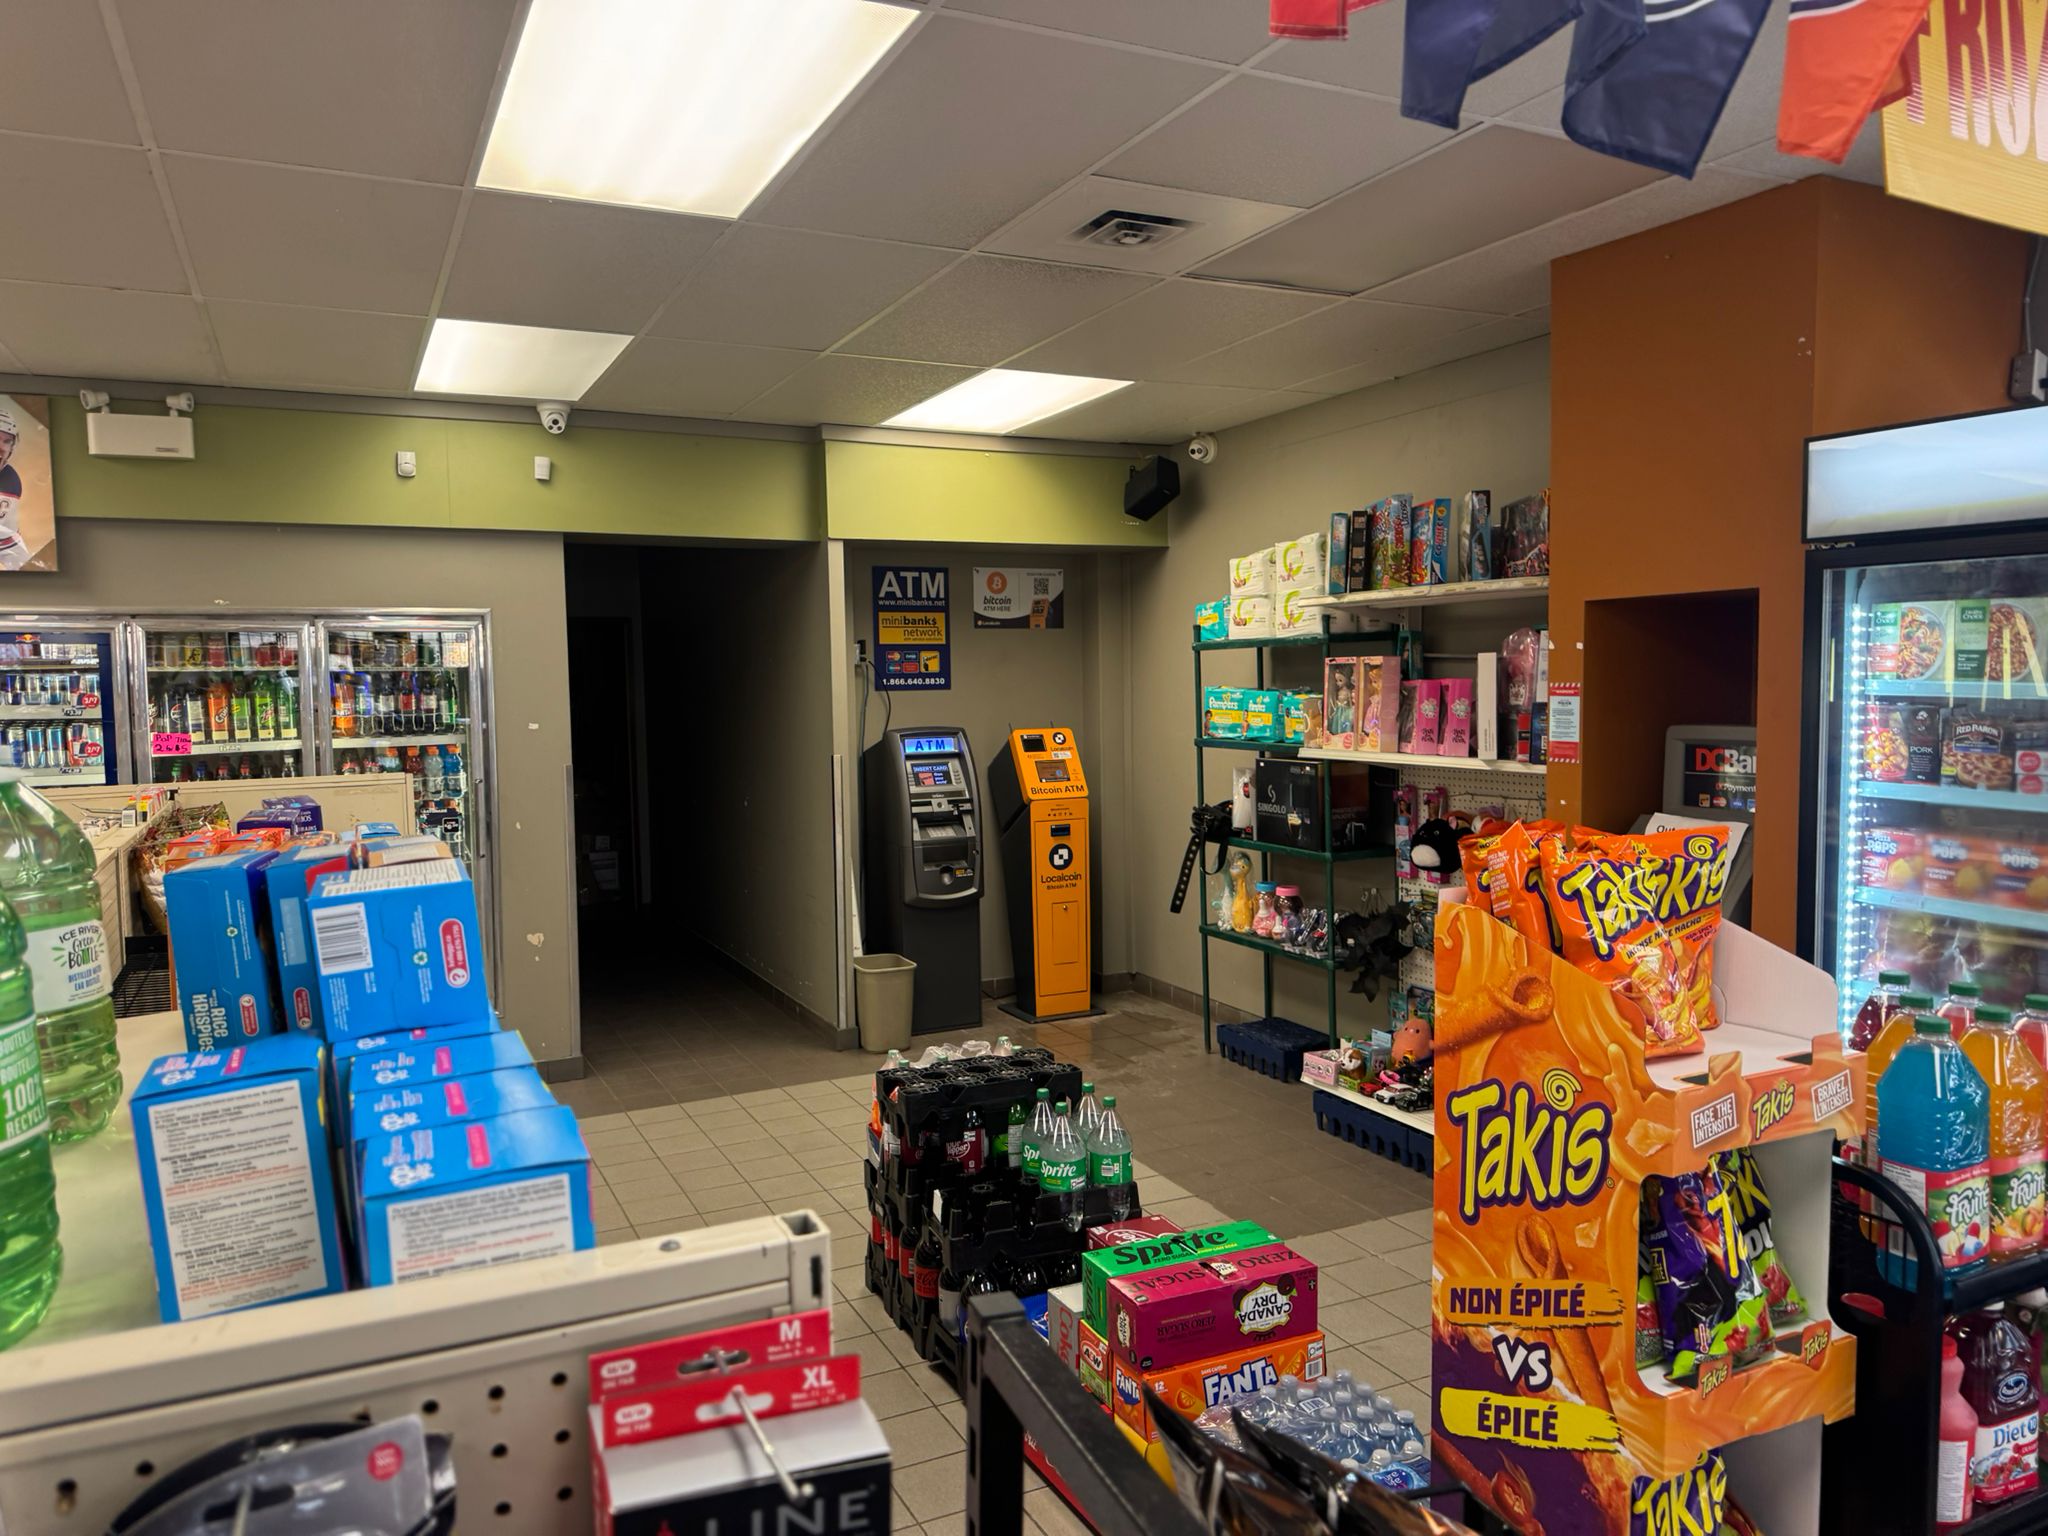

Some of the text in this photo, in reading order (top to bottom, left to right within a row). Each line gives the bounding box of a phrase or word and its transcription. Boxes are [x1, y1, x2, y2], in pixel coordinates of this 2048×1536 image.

[879, 571, 945, 598] ATM
[879, 599, 945, 607] www.minibanks.net
[984, 595, 1012, 605] bitcoin
[881, 616, 937, 626] minibanks
[904, 627, 943, 637] network
[883, 678, 945, 686] 1.866.640.8830
[1209, 697, 1239, 710] Pampers
[1956, 723, 1999, 736] RED BARON
[915, 740, 946, 751] ATM
[1696, 748, 1756, 773] DCBa
[1030, 785, 1085, 795] Bitcoin ATM
[1258, 803, 1287, 814] SINGOLO
[1867, 840, 1897, 855] POPS
[1932, 845, 1968, 861] POPS
[2001, 852, 2040, 869] POPS
[1041, 872, 1082, 884] Localcoin
[59, 929, 77, 943] ICE
[210, 1007, 228, 1038] Rice
[1817, 1075, 1847, 1102] BRAVEZ
[1694, 1098, 1733, 1129] FACE THE
[1753, 1077, 1795, 1139] Takis
[1696, 1114, 1735, 1144] INTENSITY
[1449, 1068, 1610, 1217] Takis
[1041, 1160, 1077, 1178] Sprite
[1115, 1229, 1230, 1267] Sprite
[1127, 1250, 1301, 1294] ZERO SUGAR
[1239, 1301, 1292, 1325] CANADA
[1450, 1283, 1586, 1320] NON ÉPICÉ
[779, 1319, 802, 1343] M
[1804, 1329, 1829, 1364] Takis
[1496, 1340, 1548, 1384] VS
[801, 1364, 835, 1391] XL
[1116, 1368, 1140, 1400] FANTA
[1154, 1380, 1165, 1391] 12
[1203, 1357, 1278, 1408] FANTA
[1700, 1361, 1728, 1399] Takis
[1477, 1396, 1559, 1443] ÉPICÉ
[1993, 1423, 2027, 1449] Diet
[1632, 1449, 1728, 1536] Takis
